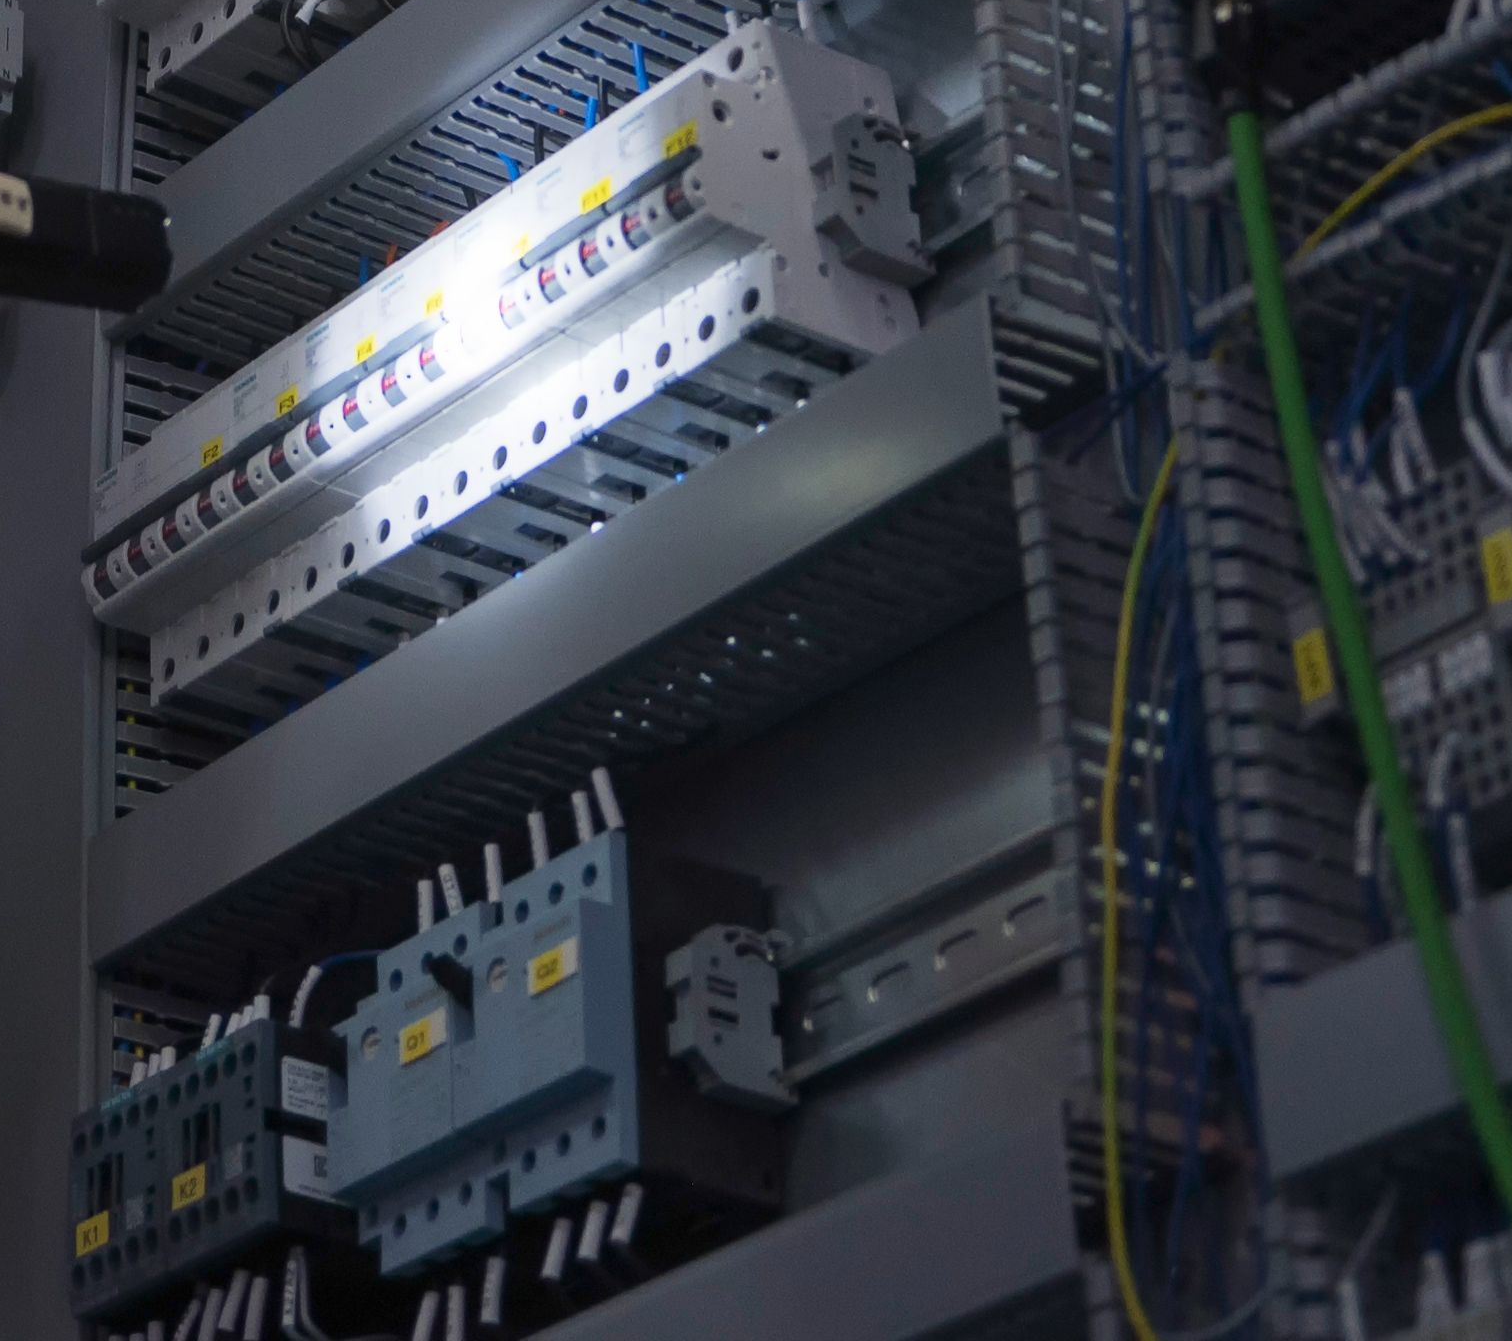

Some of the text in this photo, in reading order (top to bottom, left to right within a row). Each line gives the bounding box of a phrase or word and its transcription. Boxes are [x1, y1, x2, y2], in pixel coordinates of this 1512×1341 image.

[2, 68, 10, 80] N
[278, 395, 295, 415] F3
[202, 445, 219, 464] F2
[405, 1031, 425, 1052] Q1
[178, 1179, 198, 1200] K2
[82, 1225, 99, 1246] K1
